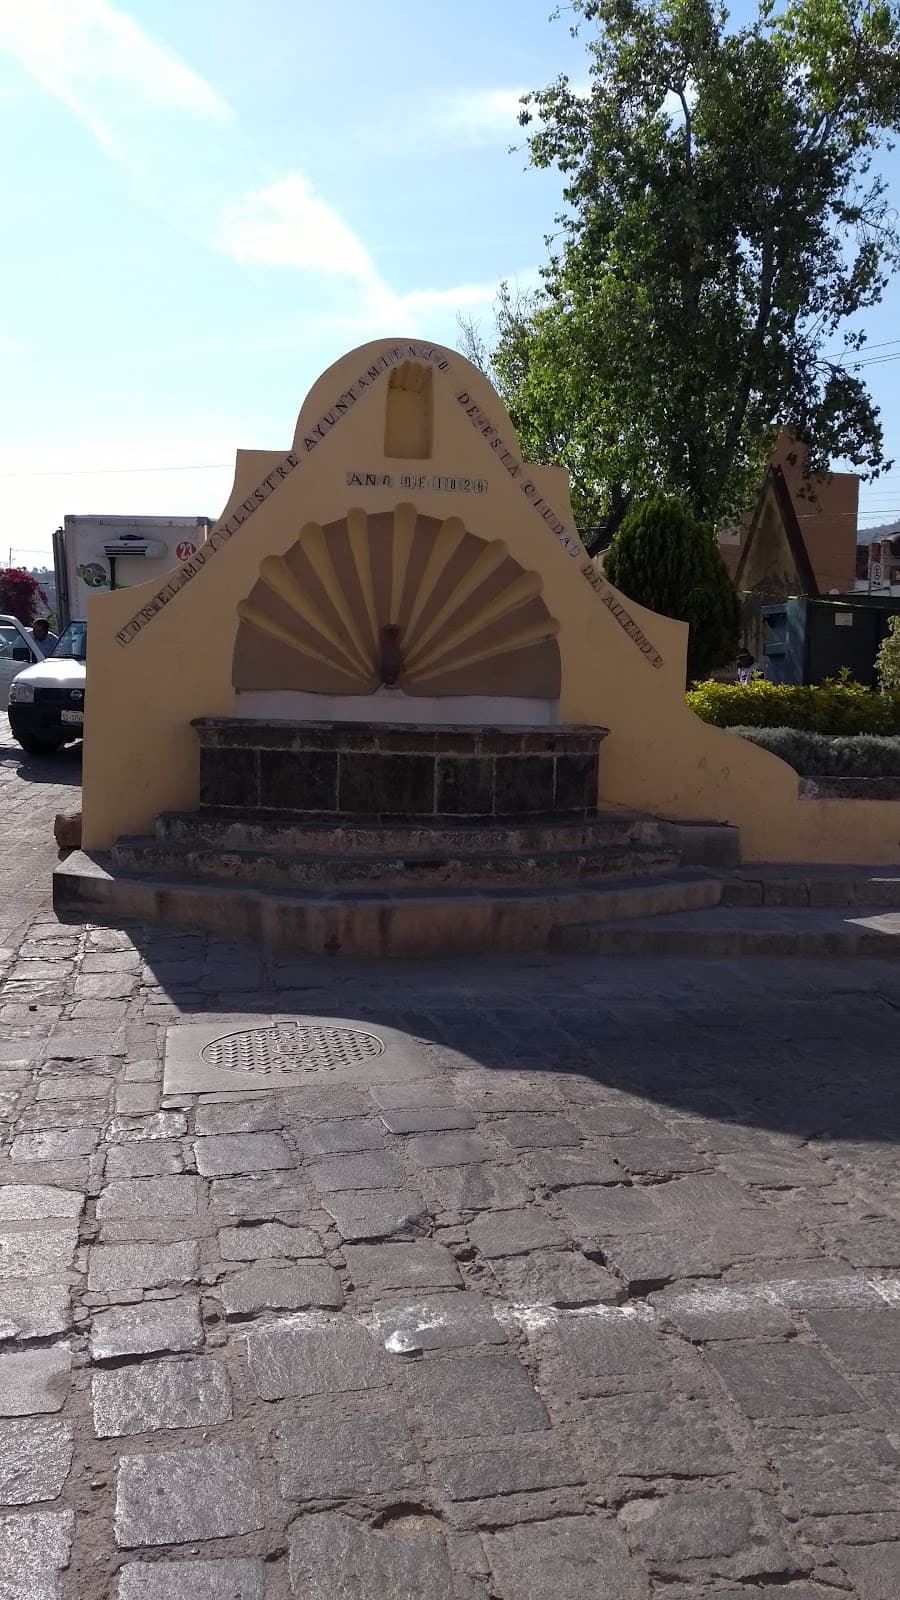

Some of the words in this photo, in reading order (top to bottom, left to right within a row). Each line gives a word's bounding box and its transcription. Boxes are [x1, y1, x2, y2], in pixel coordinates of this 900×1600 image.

[117, 606, 153, 644] POR
[157, 584, 181, 606] EL
[183, 539, 217, 578] MUY
[219, 454, 299, 537] YLUSTRE
[303, 345, 448, 451] AYUNTAMIENTO
[457, 392, 481, 418] DE
[481, 424, 520, 479] ESTA
[523, 483, 581, 558] CIUDAD
[583, 565, 605, 593] DE
[602, 597, 663, 669] ALLENDE
